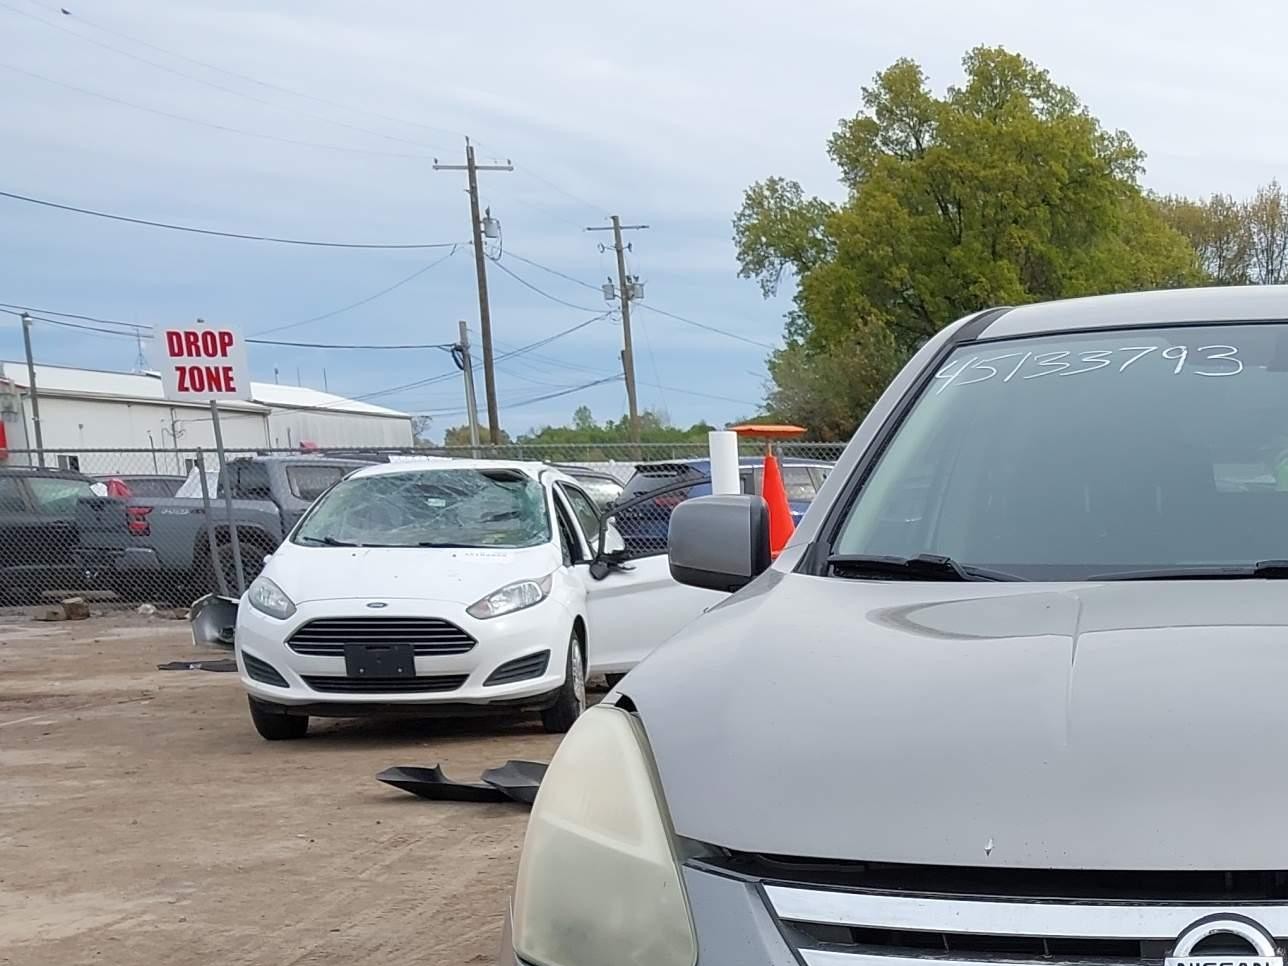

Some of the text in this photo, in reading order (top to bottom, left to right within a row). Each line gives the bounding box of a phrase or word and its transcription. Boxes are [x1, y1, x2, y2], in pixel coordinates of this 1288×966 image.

[166, 330, 234, 358] DROP
[174, 365, 237, 393] ZONE
[934, 345, 1244, 396] 45133793
